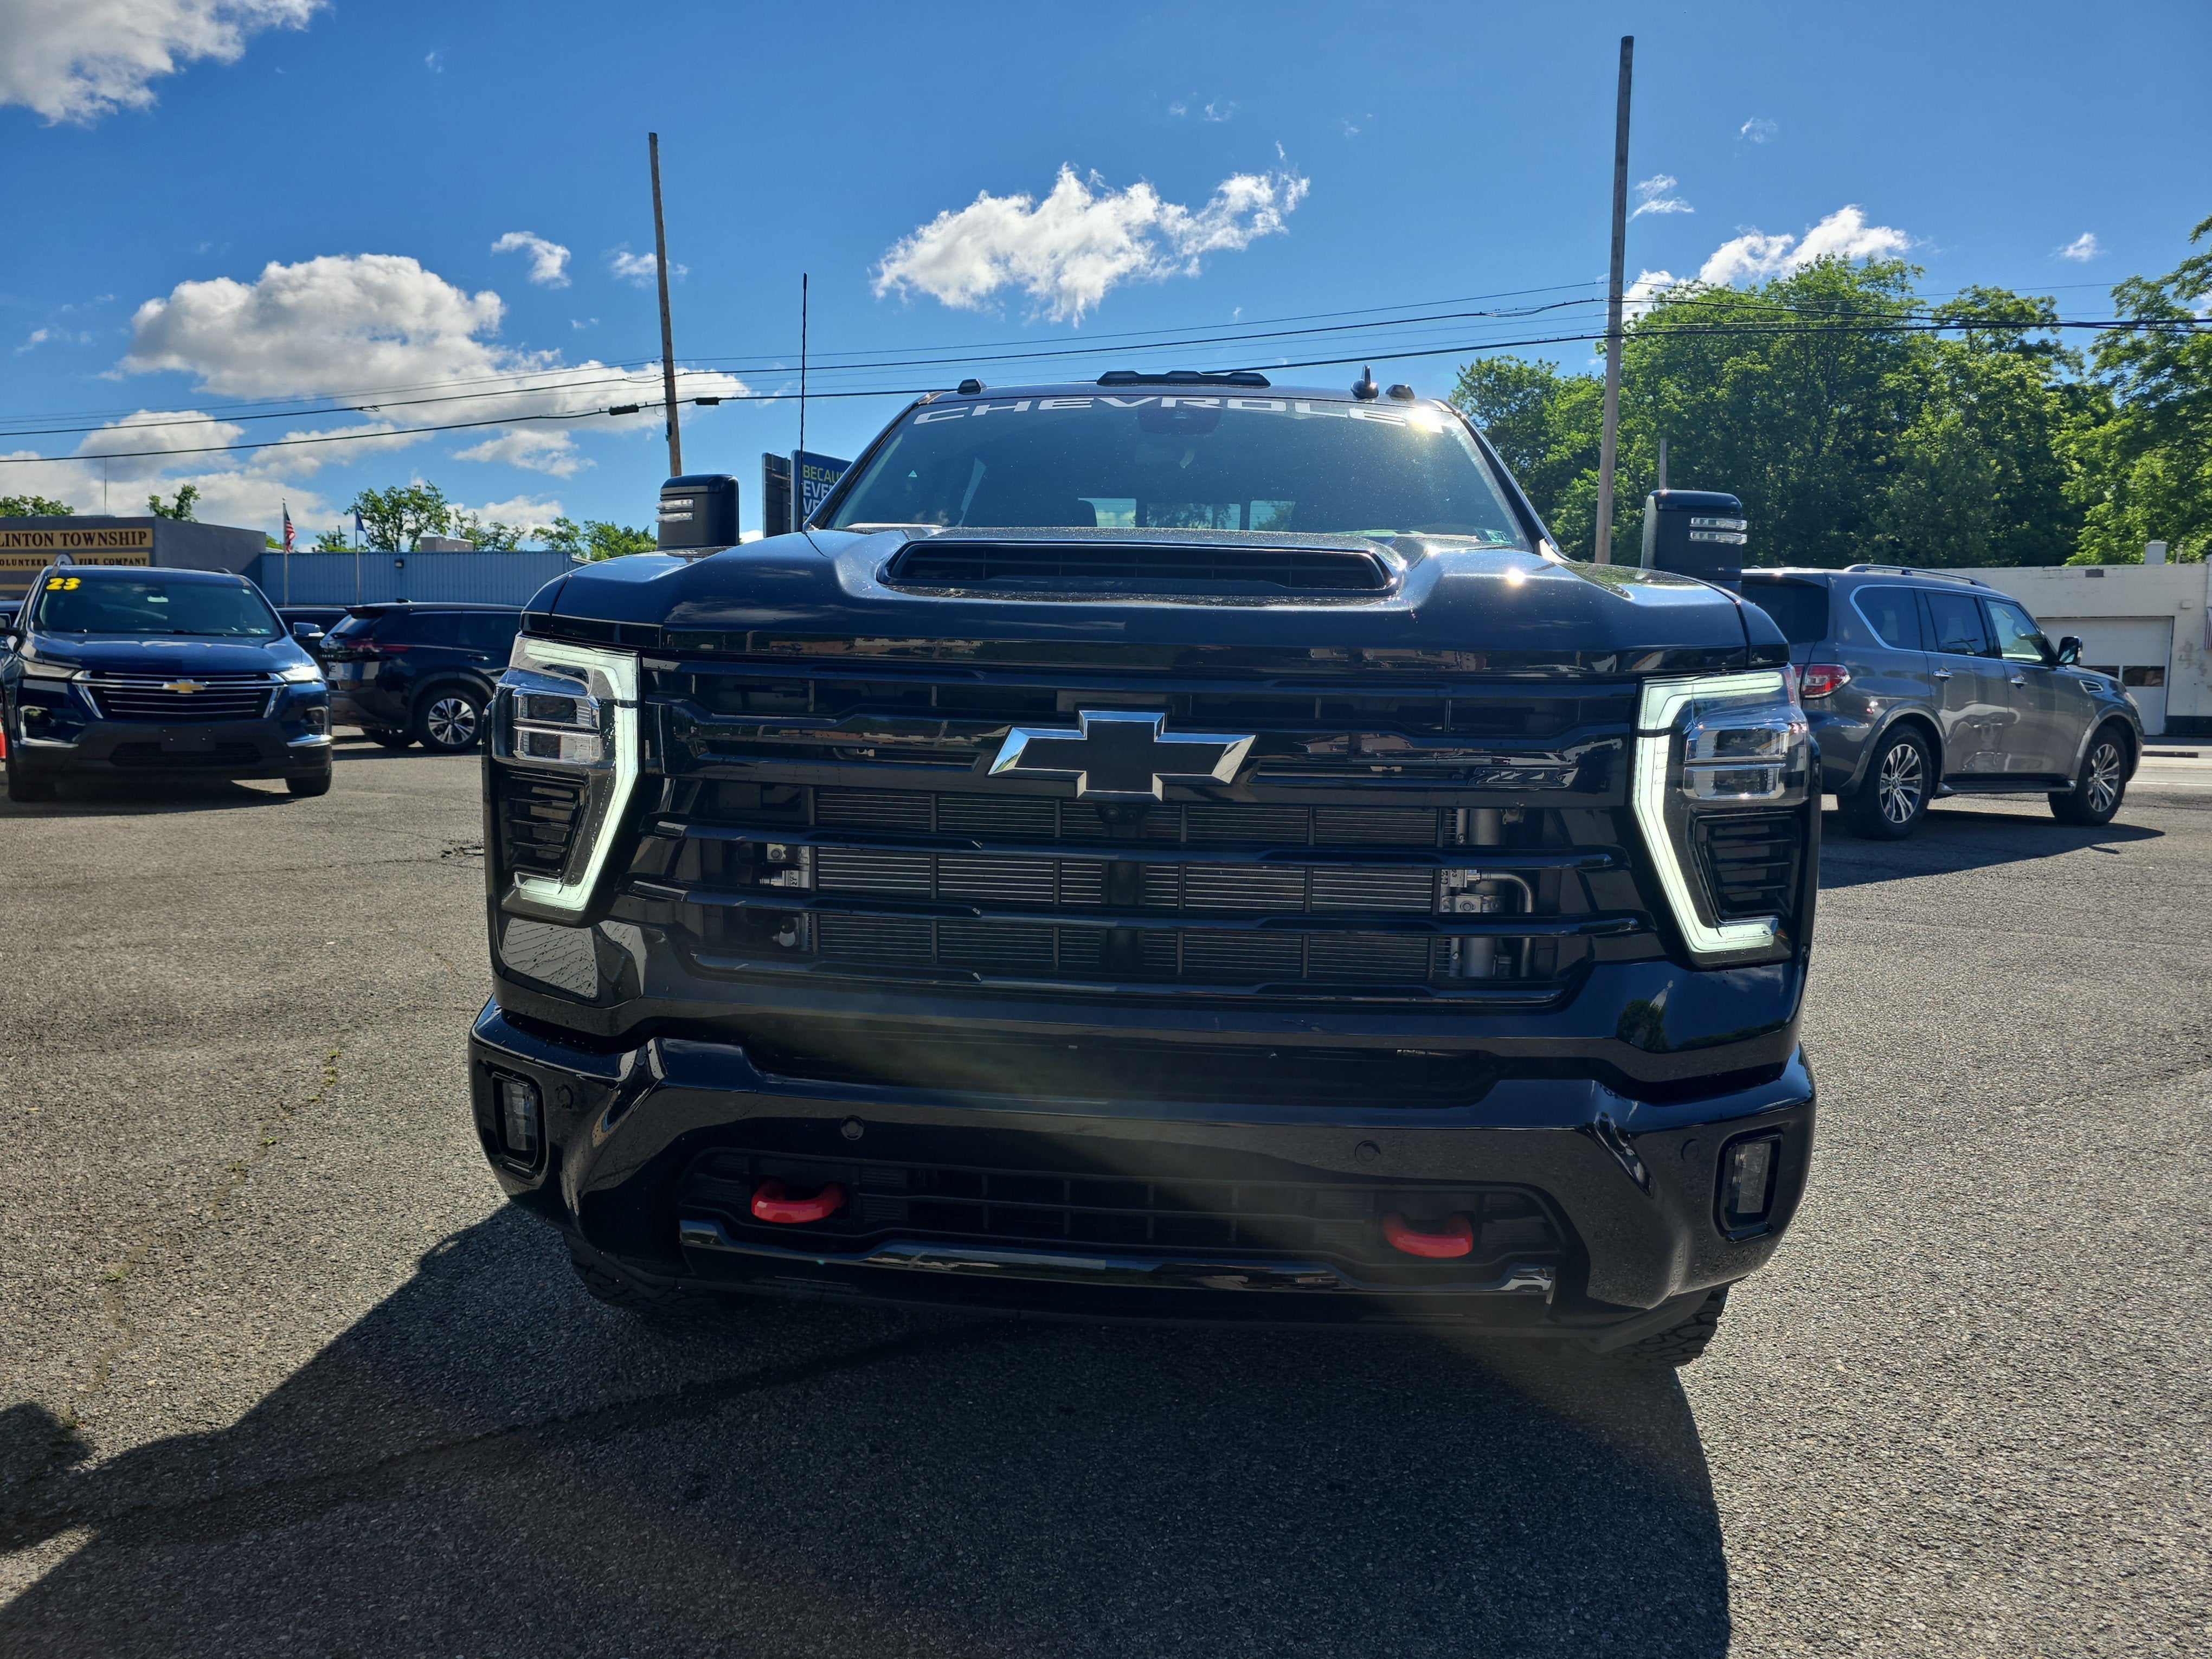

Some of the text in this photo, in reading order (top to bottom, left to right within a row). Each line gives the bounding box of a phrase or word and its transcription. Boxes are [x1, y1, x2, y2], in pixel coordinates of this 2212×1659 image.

[60, 531, 147, 547] TOWNSHIP
[103, 557, 147, 565] COMPANY
[46, 577, 81, 591] 23
